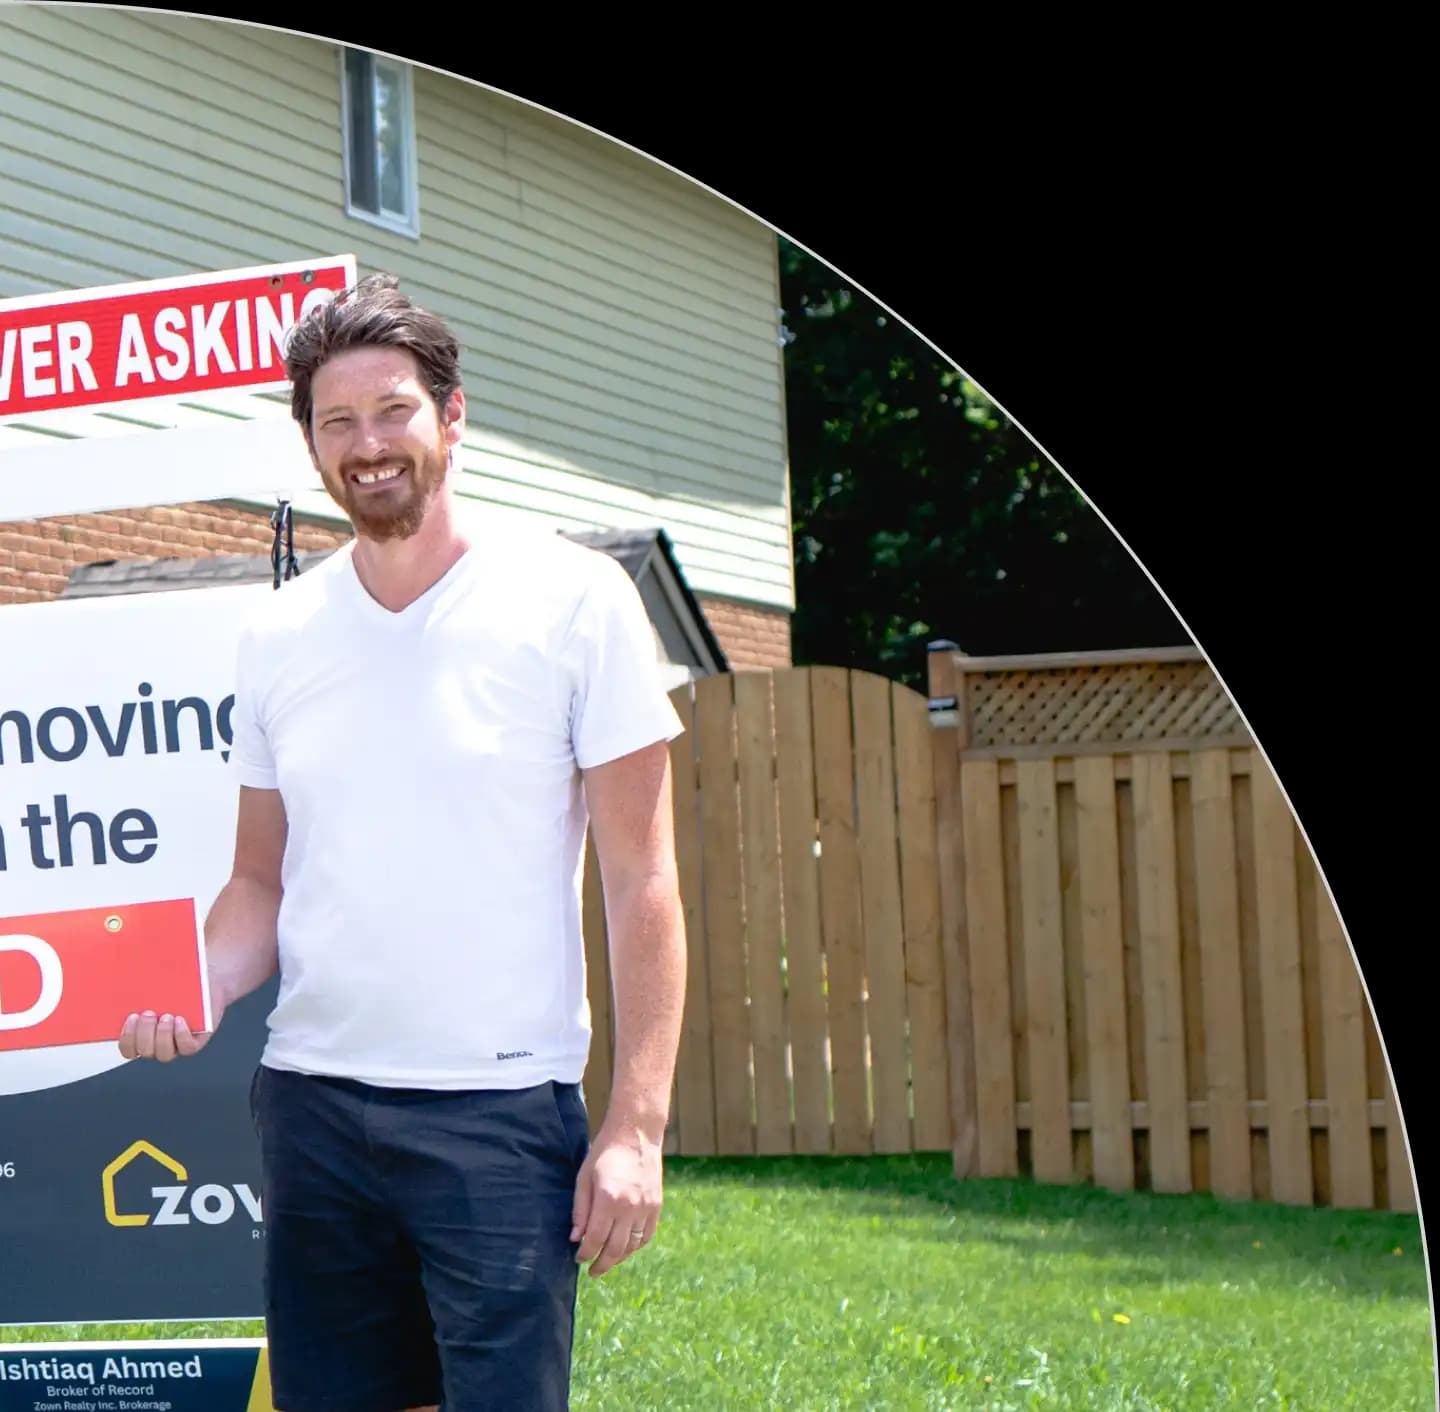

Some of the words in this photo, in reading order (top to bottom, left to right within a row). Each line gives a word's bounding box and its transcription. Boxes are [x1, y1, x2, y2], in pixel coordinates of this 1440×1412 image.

[21, 793, 159, 870] the
[102, 1355, 203, 1379] Ahmed
[46, 1385, 89, 1397] Broker
[92, 1384, 105, 1396] of
[108, 1384, 155, 1396] Record
